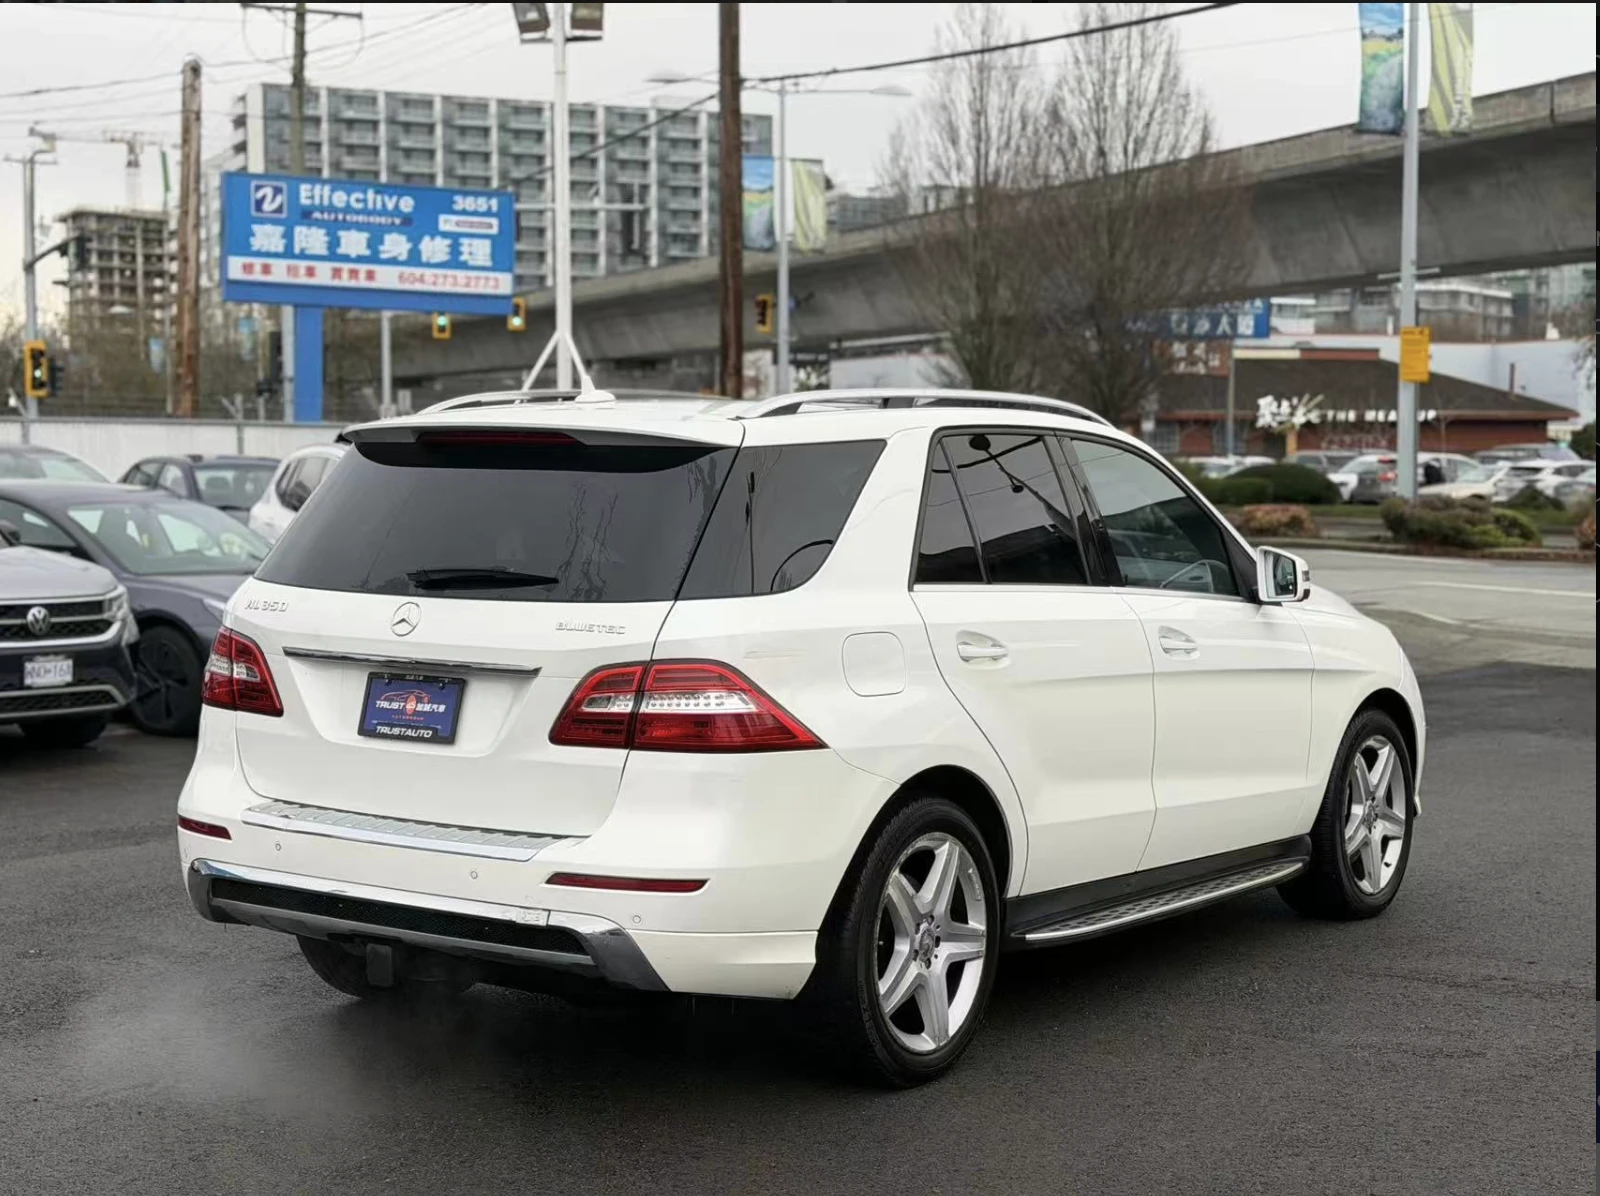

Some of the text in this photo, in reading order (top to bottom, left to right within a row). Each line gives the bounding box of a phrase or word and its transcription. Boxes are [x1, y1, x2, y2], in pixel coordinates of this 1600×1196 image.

[300, 184, 415, 213] Effective
[452, 195, 499, 213] 3651
[375, 701, 405, 710] TRUST
[376, 725, 432, 738] TRUSTAUTO
